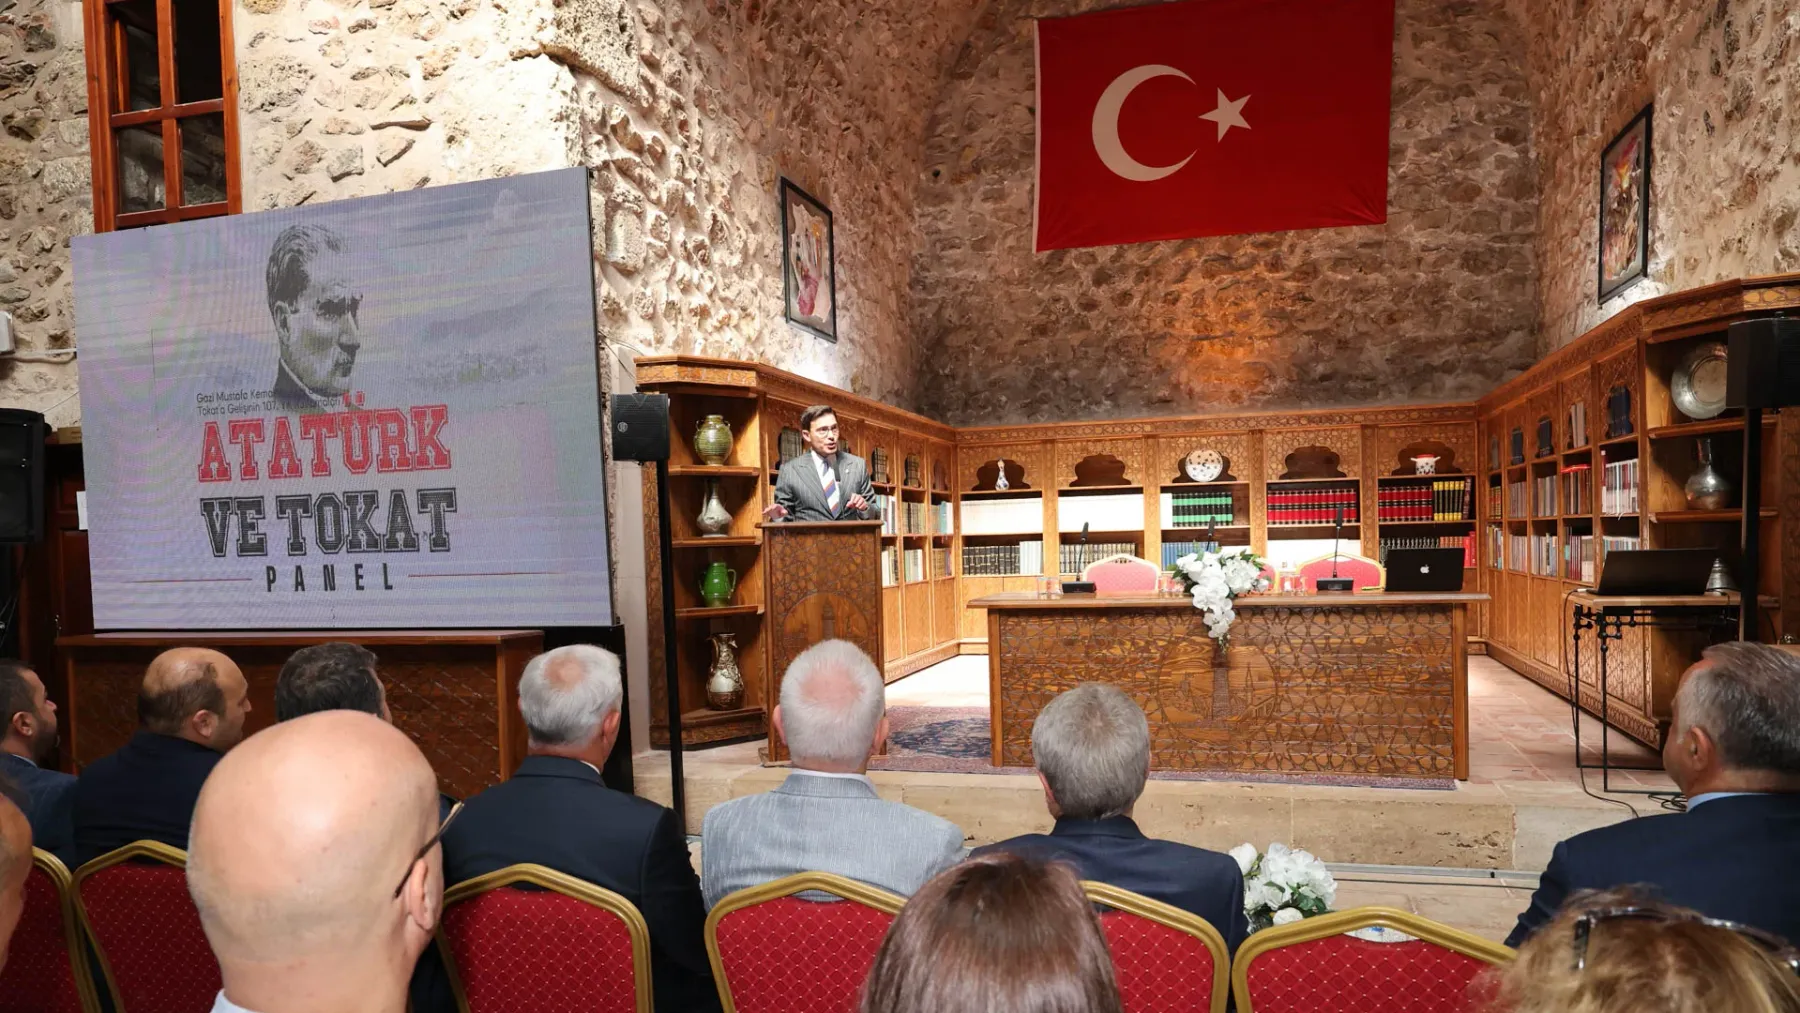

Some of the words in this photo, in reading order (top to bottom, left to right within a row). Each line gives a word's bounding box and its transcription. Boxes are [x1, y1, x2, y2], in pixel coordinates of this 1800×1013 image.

[197, 392, 215, 403] Gazi
[216, 389, 248, 402] Mustafa
[250, 388, 276, 400] Kema
[199, 391, 452, 482] ATATÜRK
[200, 496, 268, 557] VE
[276, 488, 457, 556] TOKAT
[266, 563, 393, 592] PANEL
